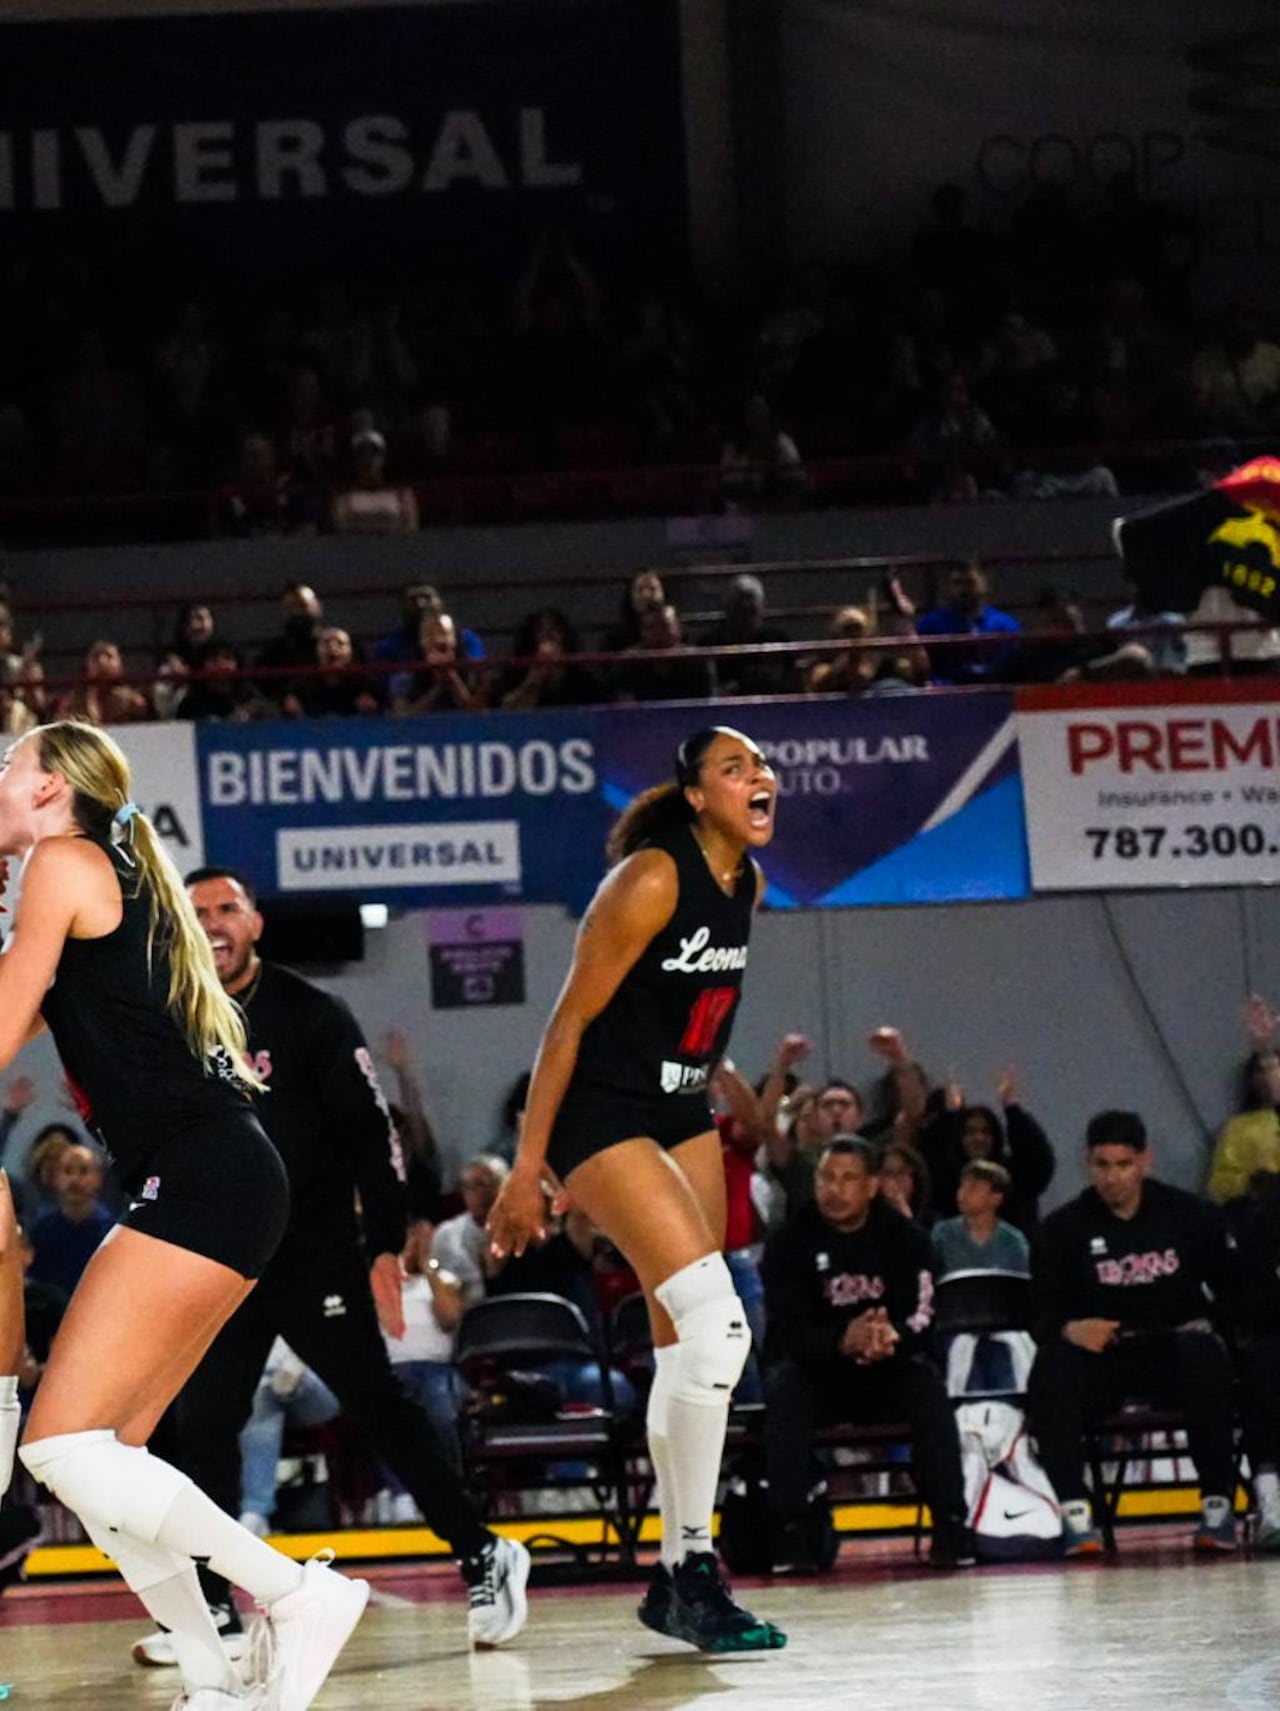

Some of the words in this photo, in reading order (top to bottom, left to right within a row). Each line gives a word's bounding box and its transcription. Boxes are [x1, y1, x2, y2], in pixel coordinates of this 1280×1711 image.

[1067, 716, 1280, 776] PREM
[209, 738, 595, 806] BIENVENIDOS
[1097, 788, 1215, 807] Insurance
[292, 840, 504, 872] UNIVERSAL
